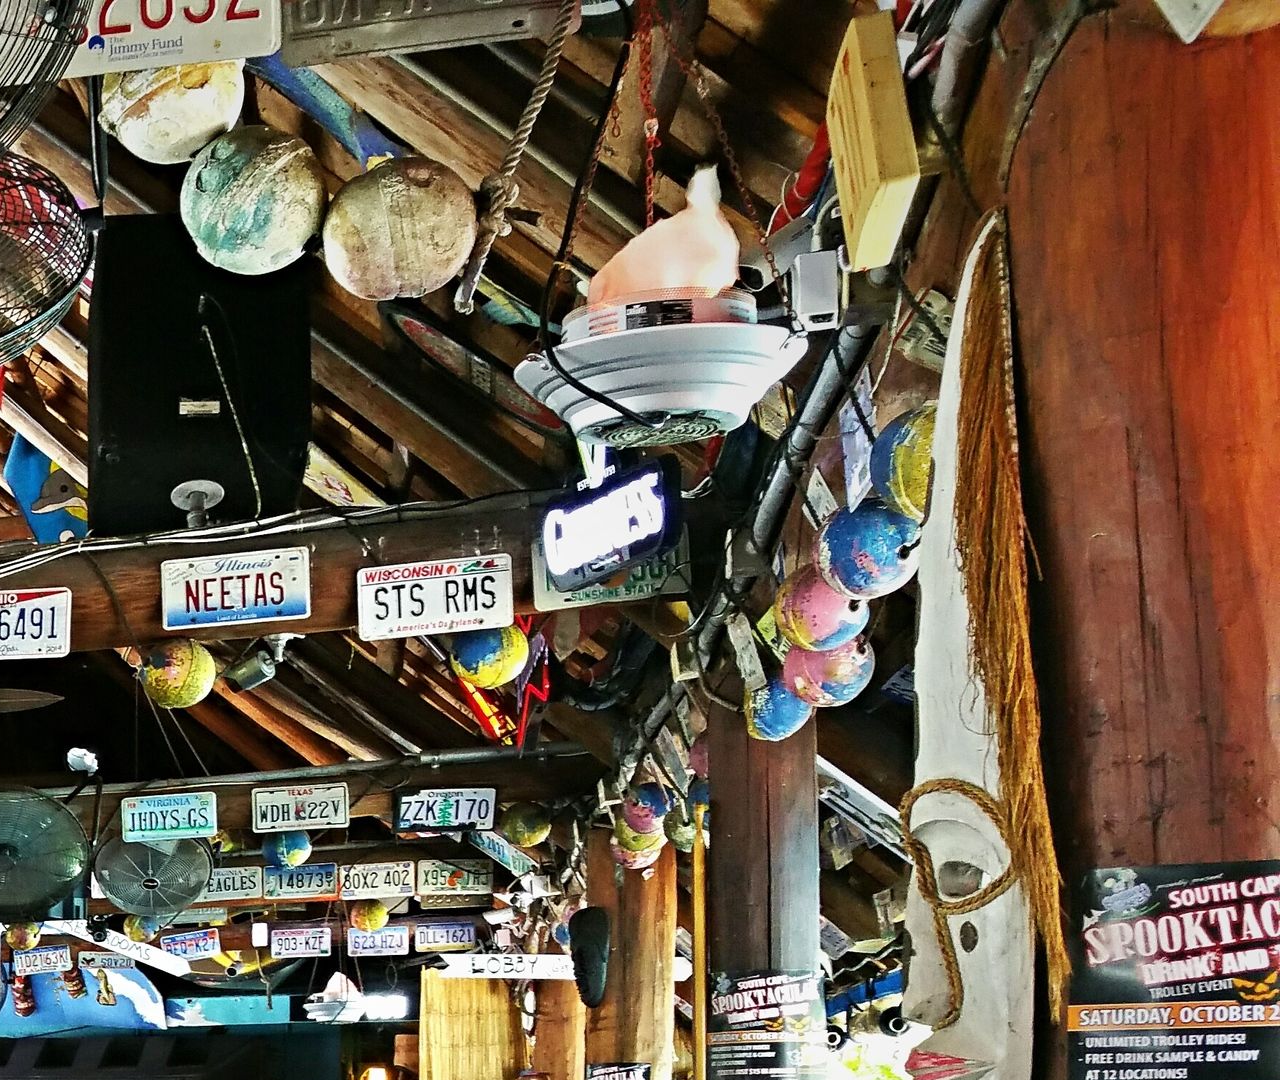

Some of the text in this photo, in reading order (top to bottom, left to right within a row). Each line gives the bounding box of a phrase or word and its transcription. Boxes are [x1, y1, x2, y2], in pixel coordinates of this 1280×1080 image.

[108, 39, 150, 56] Jimmy
[152, 36, 183, 51] Fund
[211, 558, 274, 573] Illinois
[365, 564, 445, 584] WISCONSIN
[185, 572, 285, 613] NEETAS
[374, 576, 496, 620] STS RMS
[570, 588, 620, 601] SUNSHINE
[396, 621, 436, 633] America's
[287, 788, 313, 797] TEXAS
[428, 790, 463, 801] Oregon
[143, 797, 191, 808] VIRGINIA
[259, 800, 340, 823] WDH 22V
[400, 799, 489, 821] ZZK 170
[207, 875, 258, 893] EAGLES
[277, 870, 324, 890] 14873
[384, 869, 410, 888] 402
[1168, 881, 1238, 909] SOUTH
[472, 956, 538, 974] LOBBY
[1141, 949, 1270, 986] DRINK AND
[737, 979, 766, 991] SOUTH
[1149, 978, 1234, 1000] TROLLEY EVENT
[1079, 1004, 1265, 1026] SATURDAY, OCTOBER
[741, 1032, 780, 1042] OCTOBER
[1085, 1033, 1246, 1048] UNLIMITED TROLLEY RIDES!
[1085, 1050, 1260, 1065] FREE DRINK SAMPLE & CANDY
[1085, 1068, 1188, 1080] AT 12 LOCATIONS!
